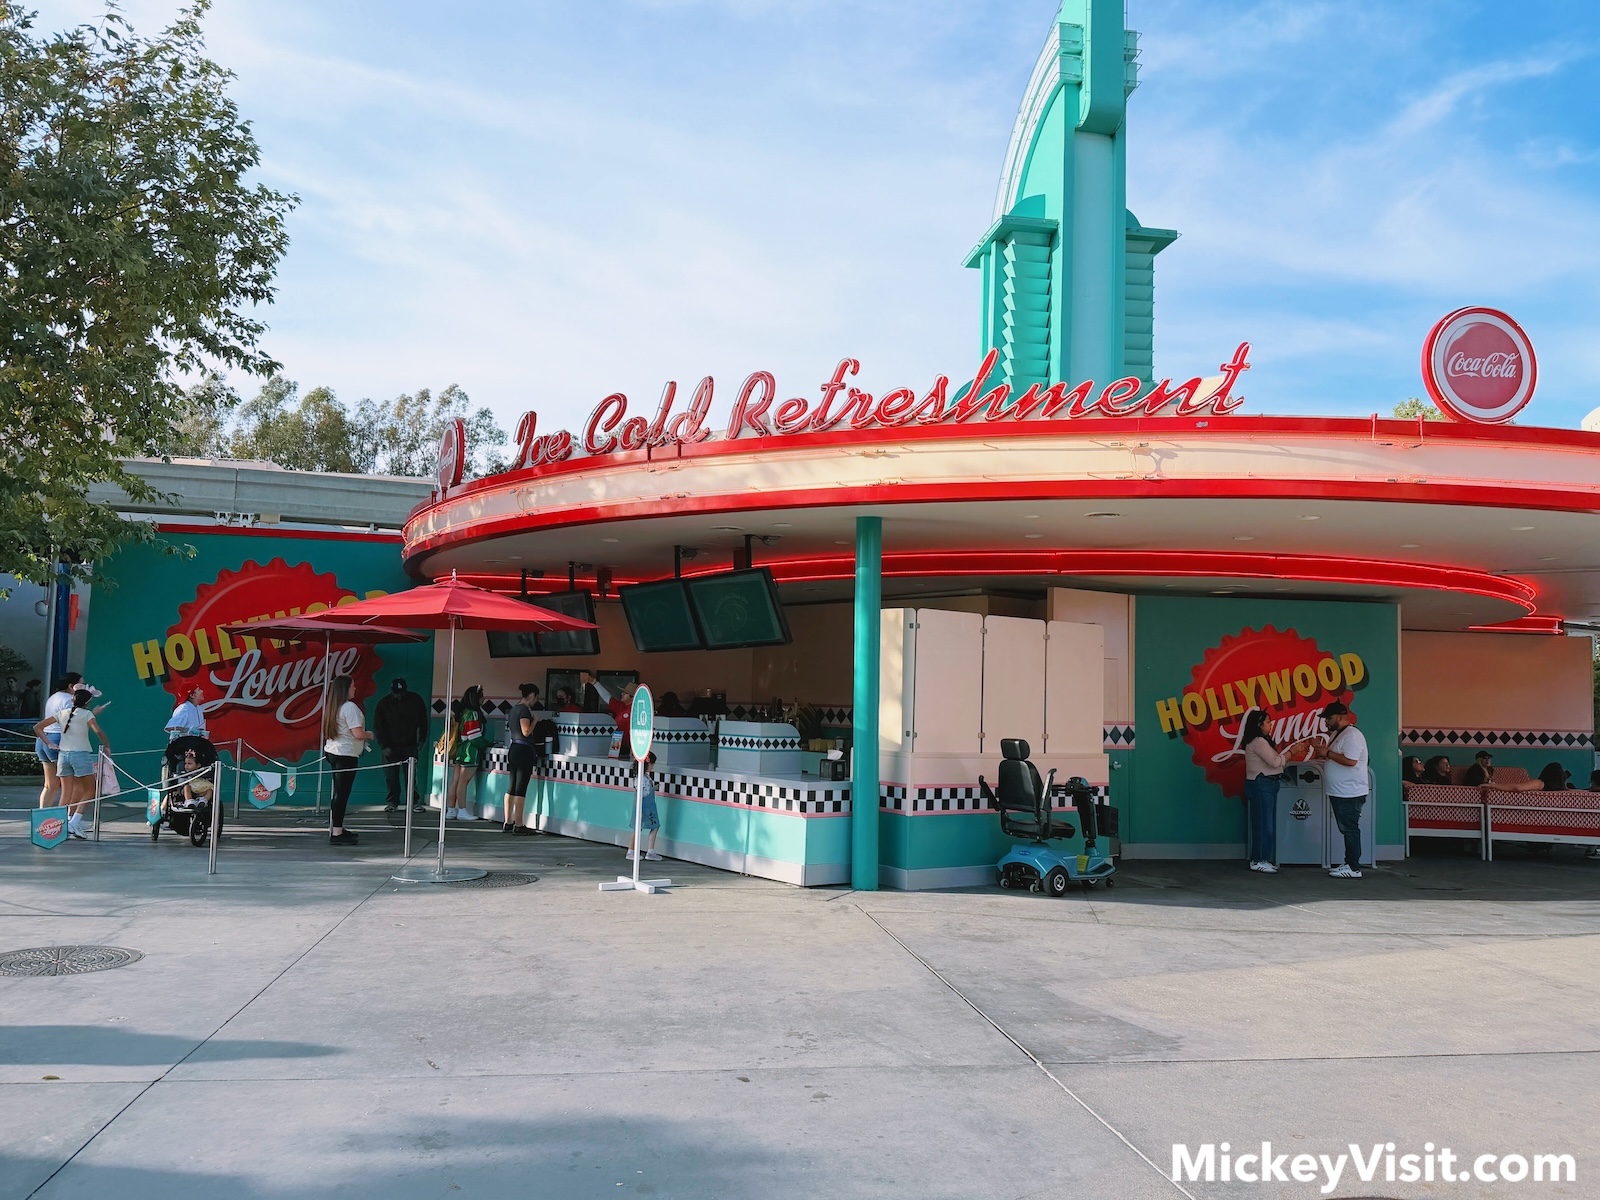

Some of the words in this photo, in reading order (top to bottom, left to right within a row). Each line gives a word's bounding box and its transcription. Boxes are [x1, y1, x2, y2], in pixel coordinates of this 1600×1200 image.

[1447, 351, 1520, 378] Coca-Cola
[506, 410, 573, 471] Ice
[581, 375, 714, 456] Cold
[725, 341, 1252, 440] Refreshment
[202, 647, 361, 725] Lounge
[1156, 652, 1365, 733] HOLLYWOOD
[1210, 705, 1330, 762] Lung
